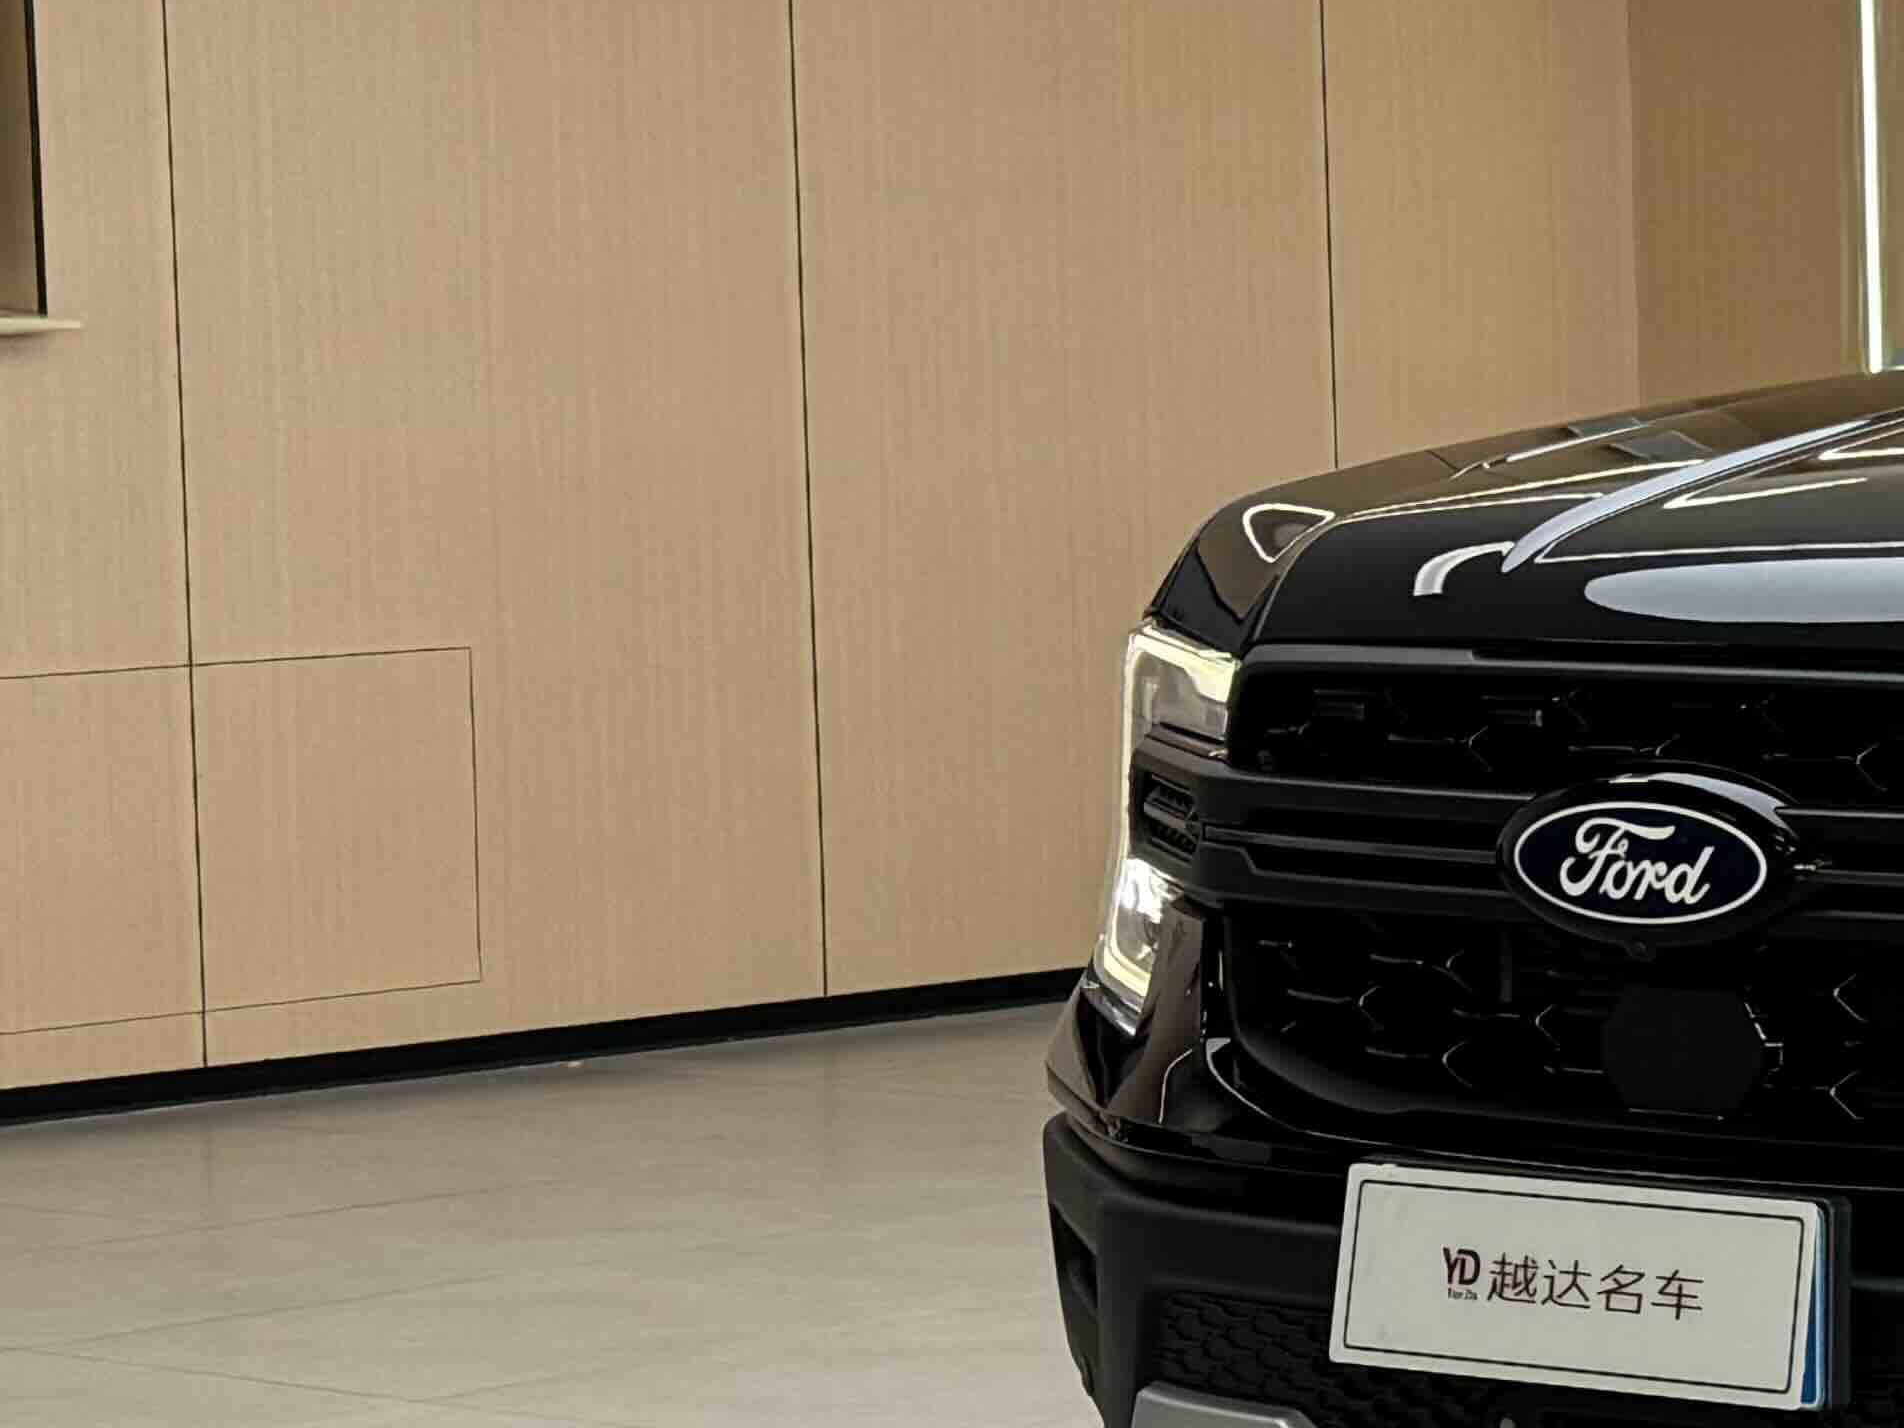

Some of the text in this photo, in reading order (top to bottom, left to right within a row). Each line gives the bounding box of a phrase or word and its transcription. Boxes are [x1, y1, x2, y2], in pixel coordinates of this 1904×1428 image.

[1560, 817, 1715, 905] Ford
[1442, 1246, 1704, 1320] YD 越达名车
